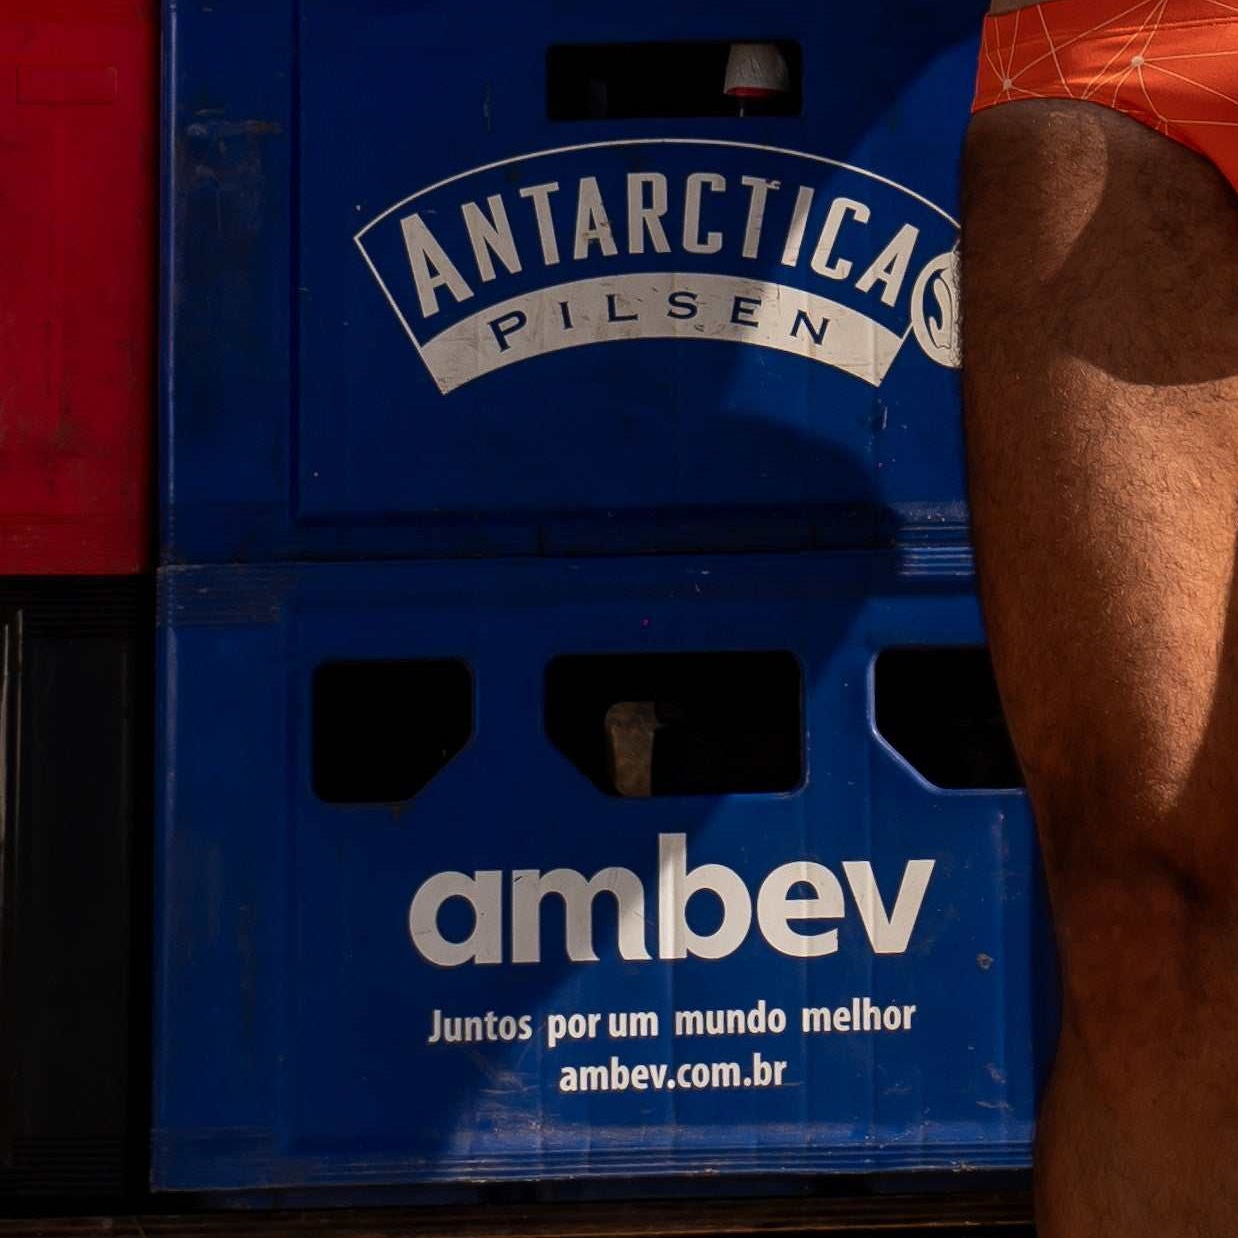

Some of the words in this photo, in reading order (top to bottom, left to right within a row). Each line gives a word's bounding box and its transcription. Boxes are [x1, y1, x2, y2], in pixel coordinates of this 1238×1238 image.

[400, 172, 920, 318] ANTARCTICA
[487, 291, 830, 353] PILSEN
[408, 832, 937, 967] ambev
[428, 1009, 533, 1043] Juntos
[548, 1013, 601, 1048] por
[608, 1011, 659, 1038] um
[675, 999, 787, 1036] mundo
[801, 997, 917, 1033] melhor
[559, 1052, 787, 1092] ambev.com.br
